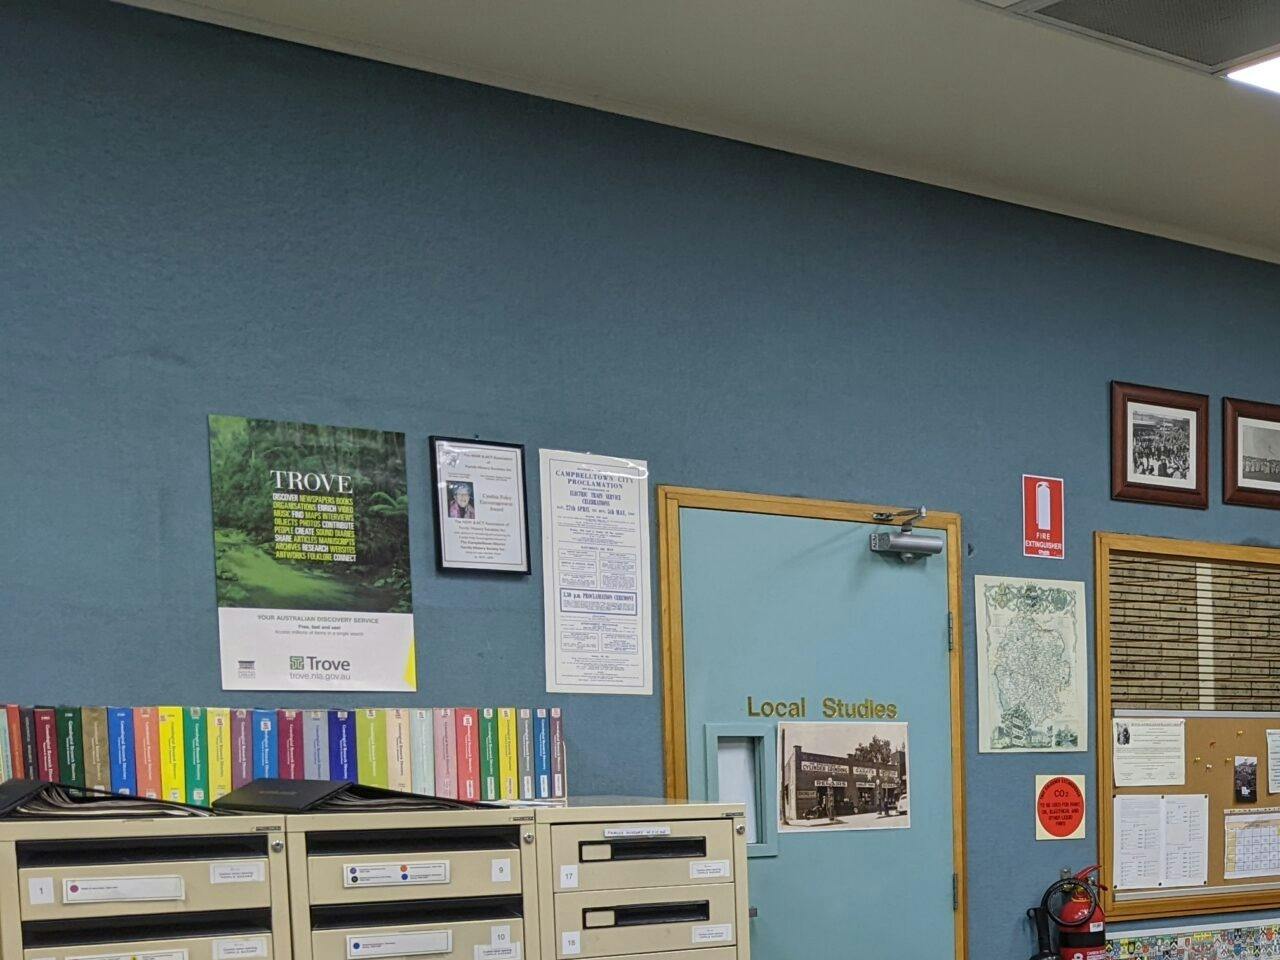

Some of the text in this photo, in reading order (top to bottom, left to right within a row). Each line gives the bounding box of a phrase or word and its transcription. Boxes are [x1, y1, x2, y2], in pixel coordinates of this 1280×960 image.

[270, 470, 353, 494] TROVE
[556, 470, 634, 484] CAMPBELLTOWN CITY
[568, 478, 623, 489] PROCLAMATION
[272, 493, 354, 506] DISCOVER NEWSPAPERS BOOKS
[318, 504, 336, 512] ENRICH
[274, 510, 290, 518] MUSIC
[292, 510, 304, 518] FIND
[305, 512, 322, 520] MAPS
[274, 518, 354, 530] OBJECTS PHOTOS CONTRIBUTE
[274, 526, 294, 534] PEOPLE
[294, 527, 314, 535] CREATE
[316, 528, 334, 536] SOUND
[1036, 532, 1050, 540] FIRE
[274, 534, 292, 542] SHARE
[294, 536, 318, 544] ARTICLES
[276, 542, 356, 554] ARCHIVES RESEARCH WEBSITES
[1026, 540, 1062, 550] EXTINGUISHER
[276, 550, 306, 559] ARTWORKS
[334, 554, 356, 562] CONNECT
[306, 656, 350, 670] Trove
[747, 696, 898, 720] Local Studies
[498, 866, 504, 874] 9
[39, 887, 44, 895] 1
[497, 933, 506, 941] 10
